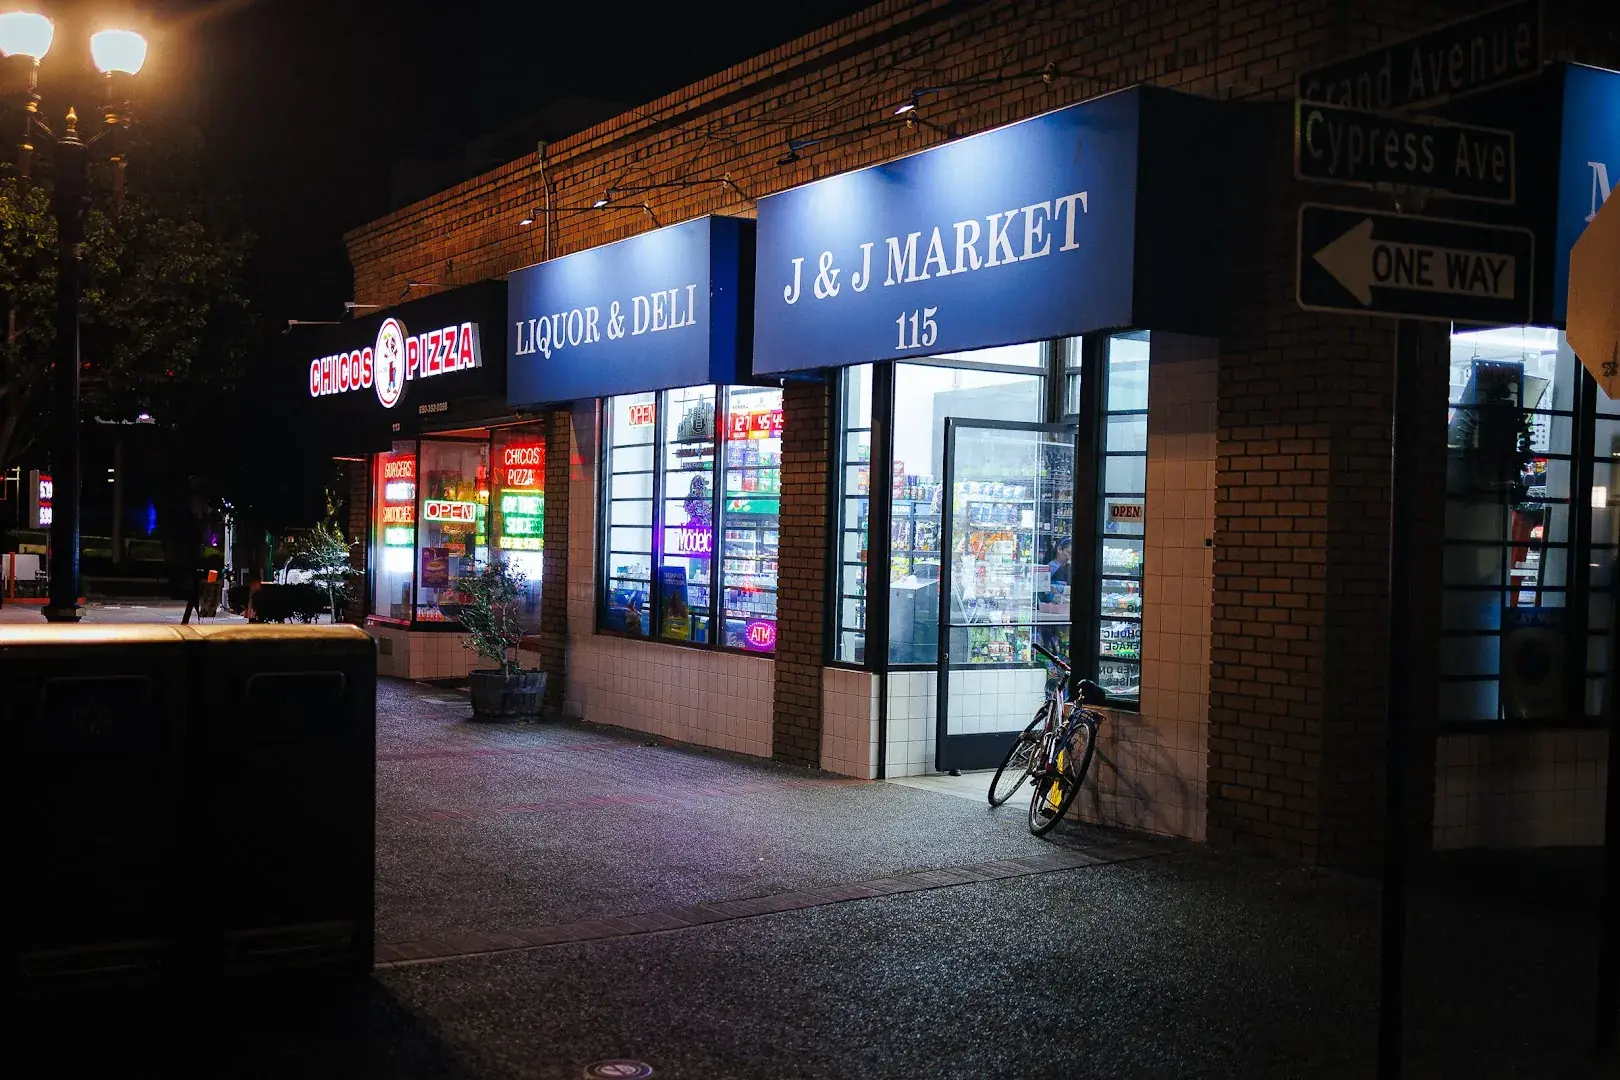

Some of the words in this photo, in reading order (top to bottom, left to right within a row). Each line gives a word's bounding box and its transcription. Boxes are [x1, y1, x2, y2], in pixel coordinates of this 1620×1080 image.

[1408, 21, 1532, 98] Avenue
[1306, 109, 1435, 175] Cypress
[1455, 133, 1506, 183] Ave
[783, 257, 804, 305] J
[813, 250, 840, 298] &
[851, 242, 874, 292] J
[883, 191, 1089, 287] MARKET
[1373, 245, 1433, 286] ONE
[1446, 252, 1508, 294] WAY
[515, 304, 601, 360] LIQUOR
[606, 300, 625, 341] &
[631, 283, 698, 336] DELI
[895, 306, 939, 351] 115
[310, 346, 373, 398] CHICOS
[405, 322, 476, 380] PIZZA
[629, 404, 655, 426] OPEN
[504, 448, 539, 466] CHICOS
[426, 502, 473, 520] OPEN
[1112, 505, 1141, 518] OPEN
[750, 626, 770, 643] ATM
